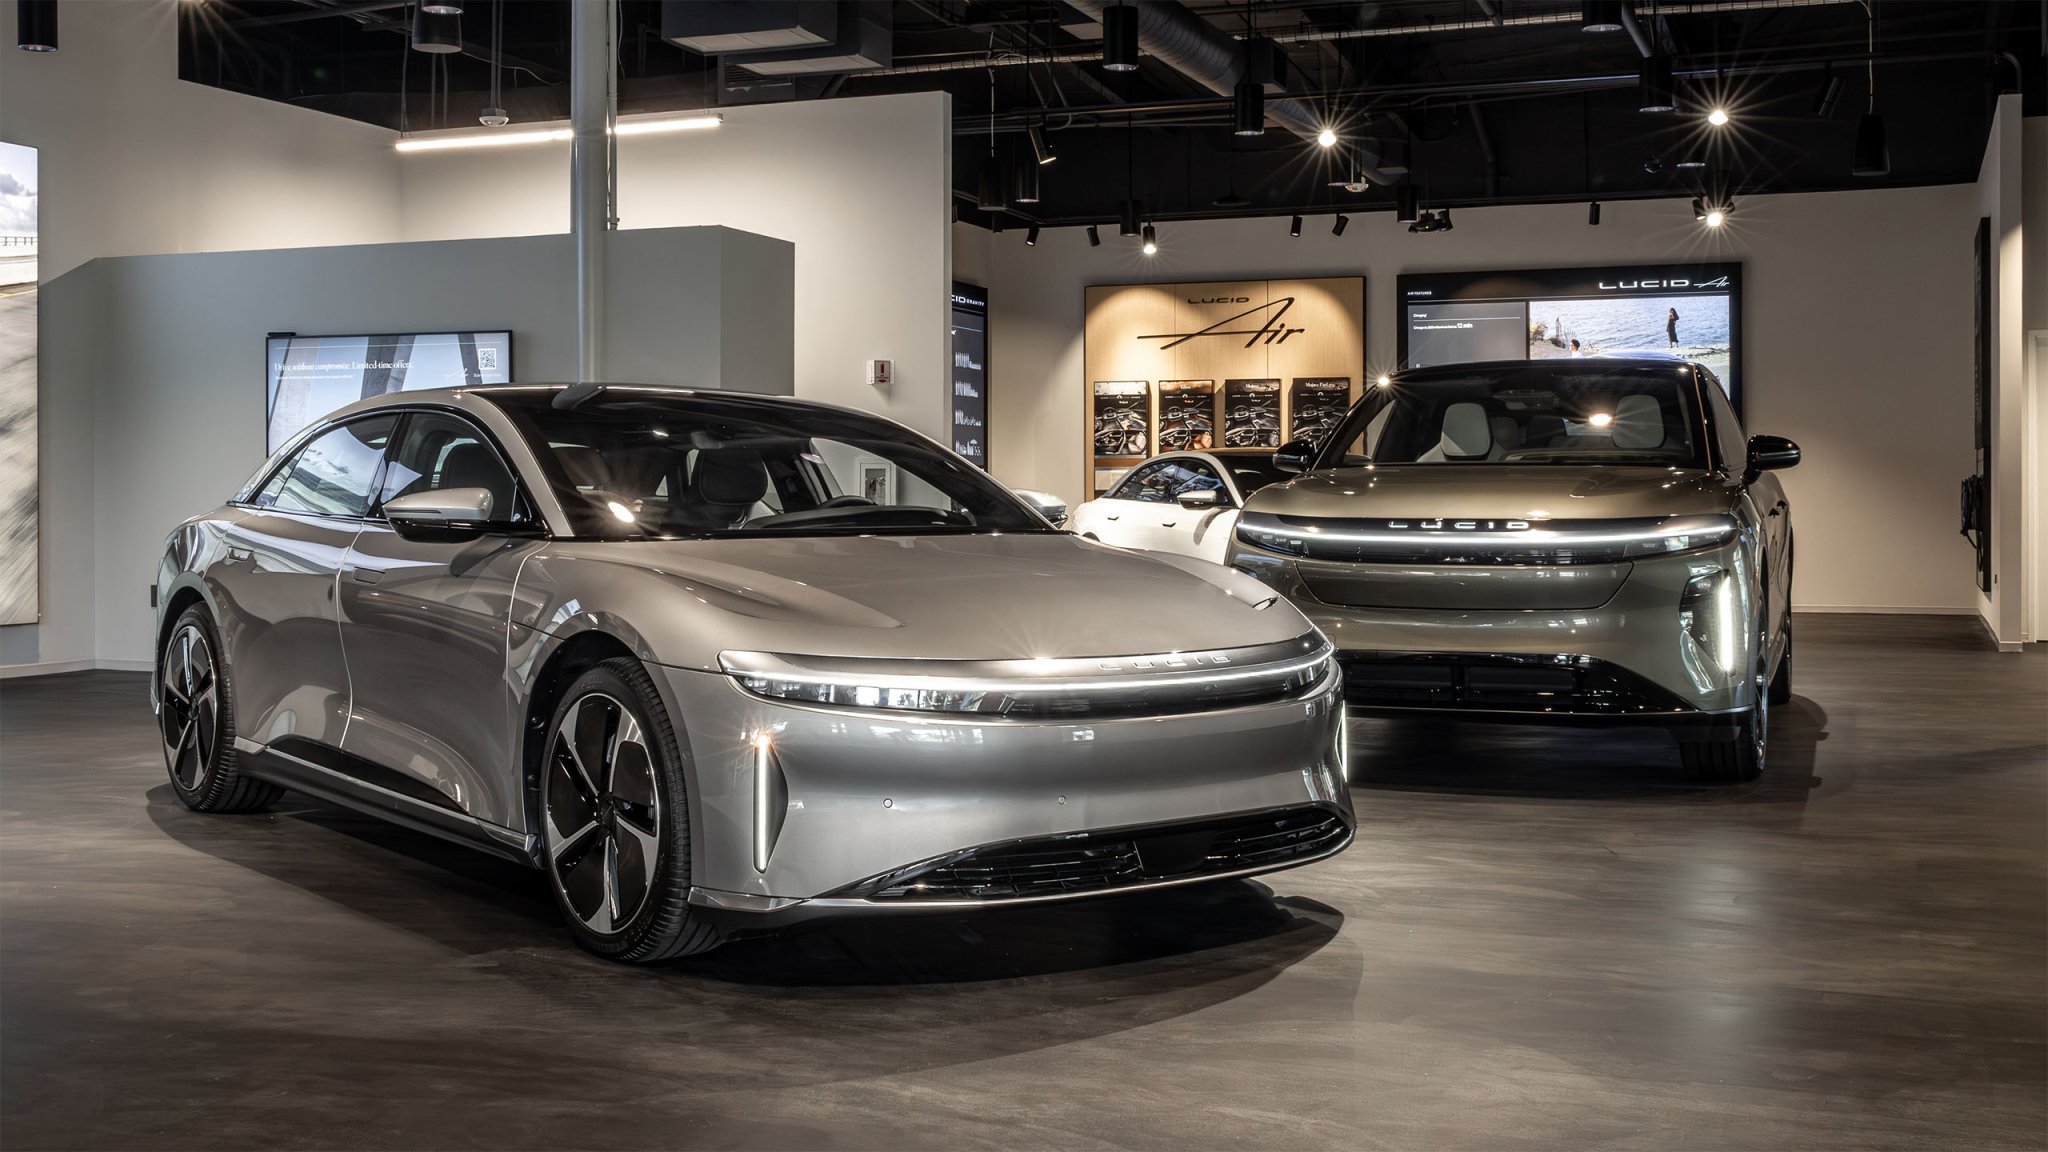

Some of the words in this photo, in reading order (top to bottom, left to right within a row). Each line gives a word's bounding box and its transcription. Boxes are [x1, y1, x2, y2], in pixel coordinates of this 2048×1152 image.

[1599, 279, 1690, 290] LUCID
[1693, 276, 1730, 288] Air
[951, 294, 966, 303] CID
[1136, 297, 1306, 350] Air
[274, 363, 291, 371] Drive
[352, 360, 392, 370] Limited-time
[1388, 521, 1529, 529] LUCID
[1098, 655, 1232, 671] LUCID
